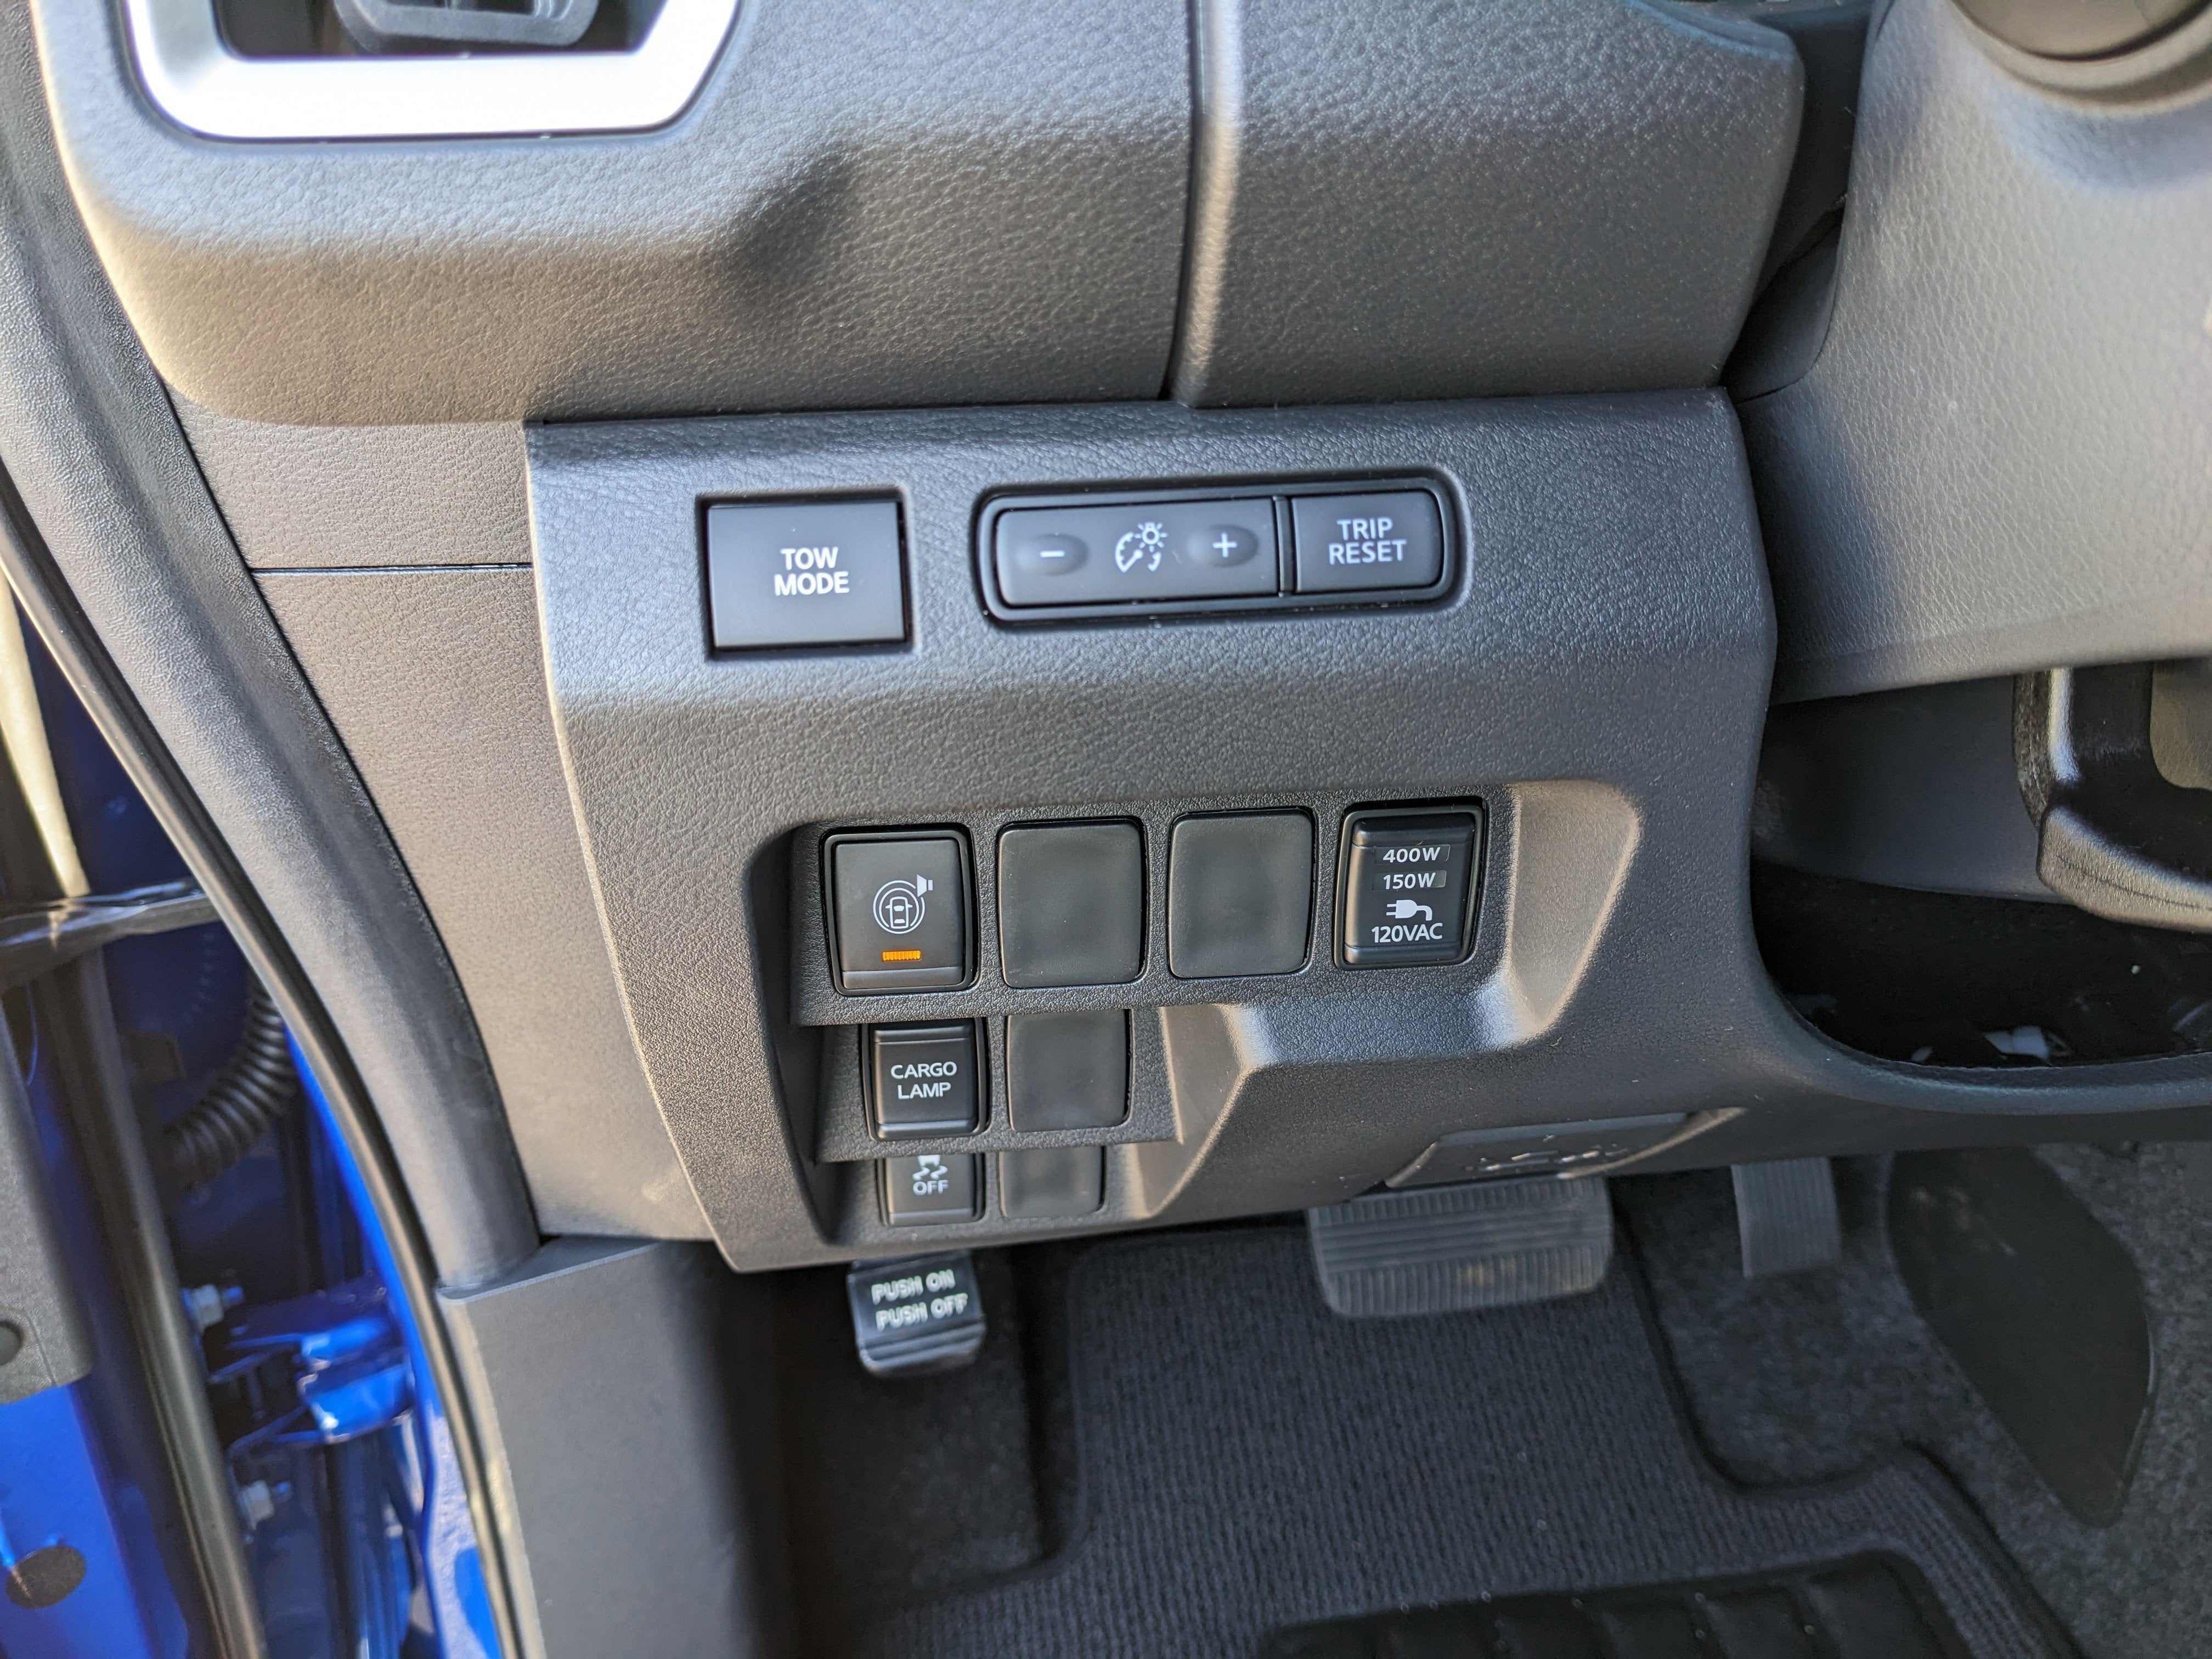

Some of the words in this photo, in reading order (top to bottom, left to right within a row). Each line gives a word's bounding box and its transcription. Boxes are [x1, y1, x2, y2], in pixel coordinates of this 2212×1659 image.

[1336, 517, 1393, 541] TRIP
[780, 546, 838, 571] TOW
[1329, 539, 1407, 565] RESET
[774, 571, 850, 596] MODE
[1383, 847, 1441, 864] 400W
[1383, 872, 1436, 890] 150W
[1371, 922, 1443, 943] 120VAC
[890, 1061, 957, 1079] CARGO
[898, 1082, 952, 1099] LAMP
[912, 1179, 949, 1195] OFF
[871, 1277, 924, 1302] PUSH
[926, 1269, 956, 1291] ON
[876, 1301, 927, 1330] PUSH
[929, 1293, 968, 1317] OFF
